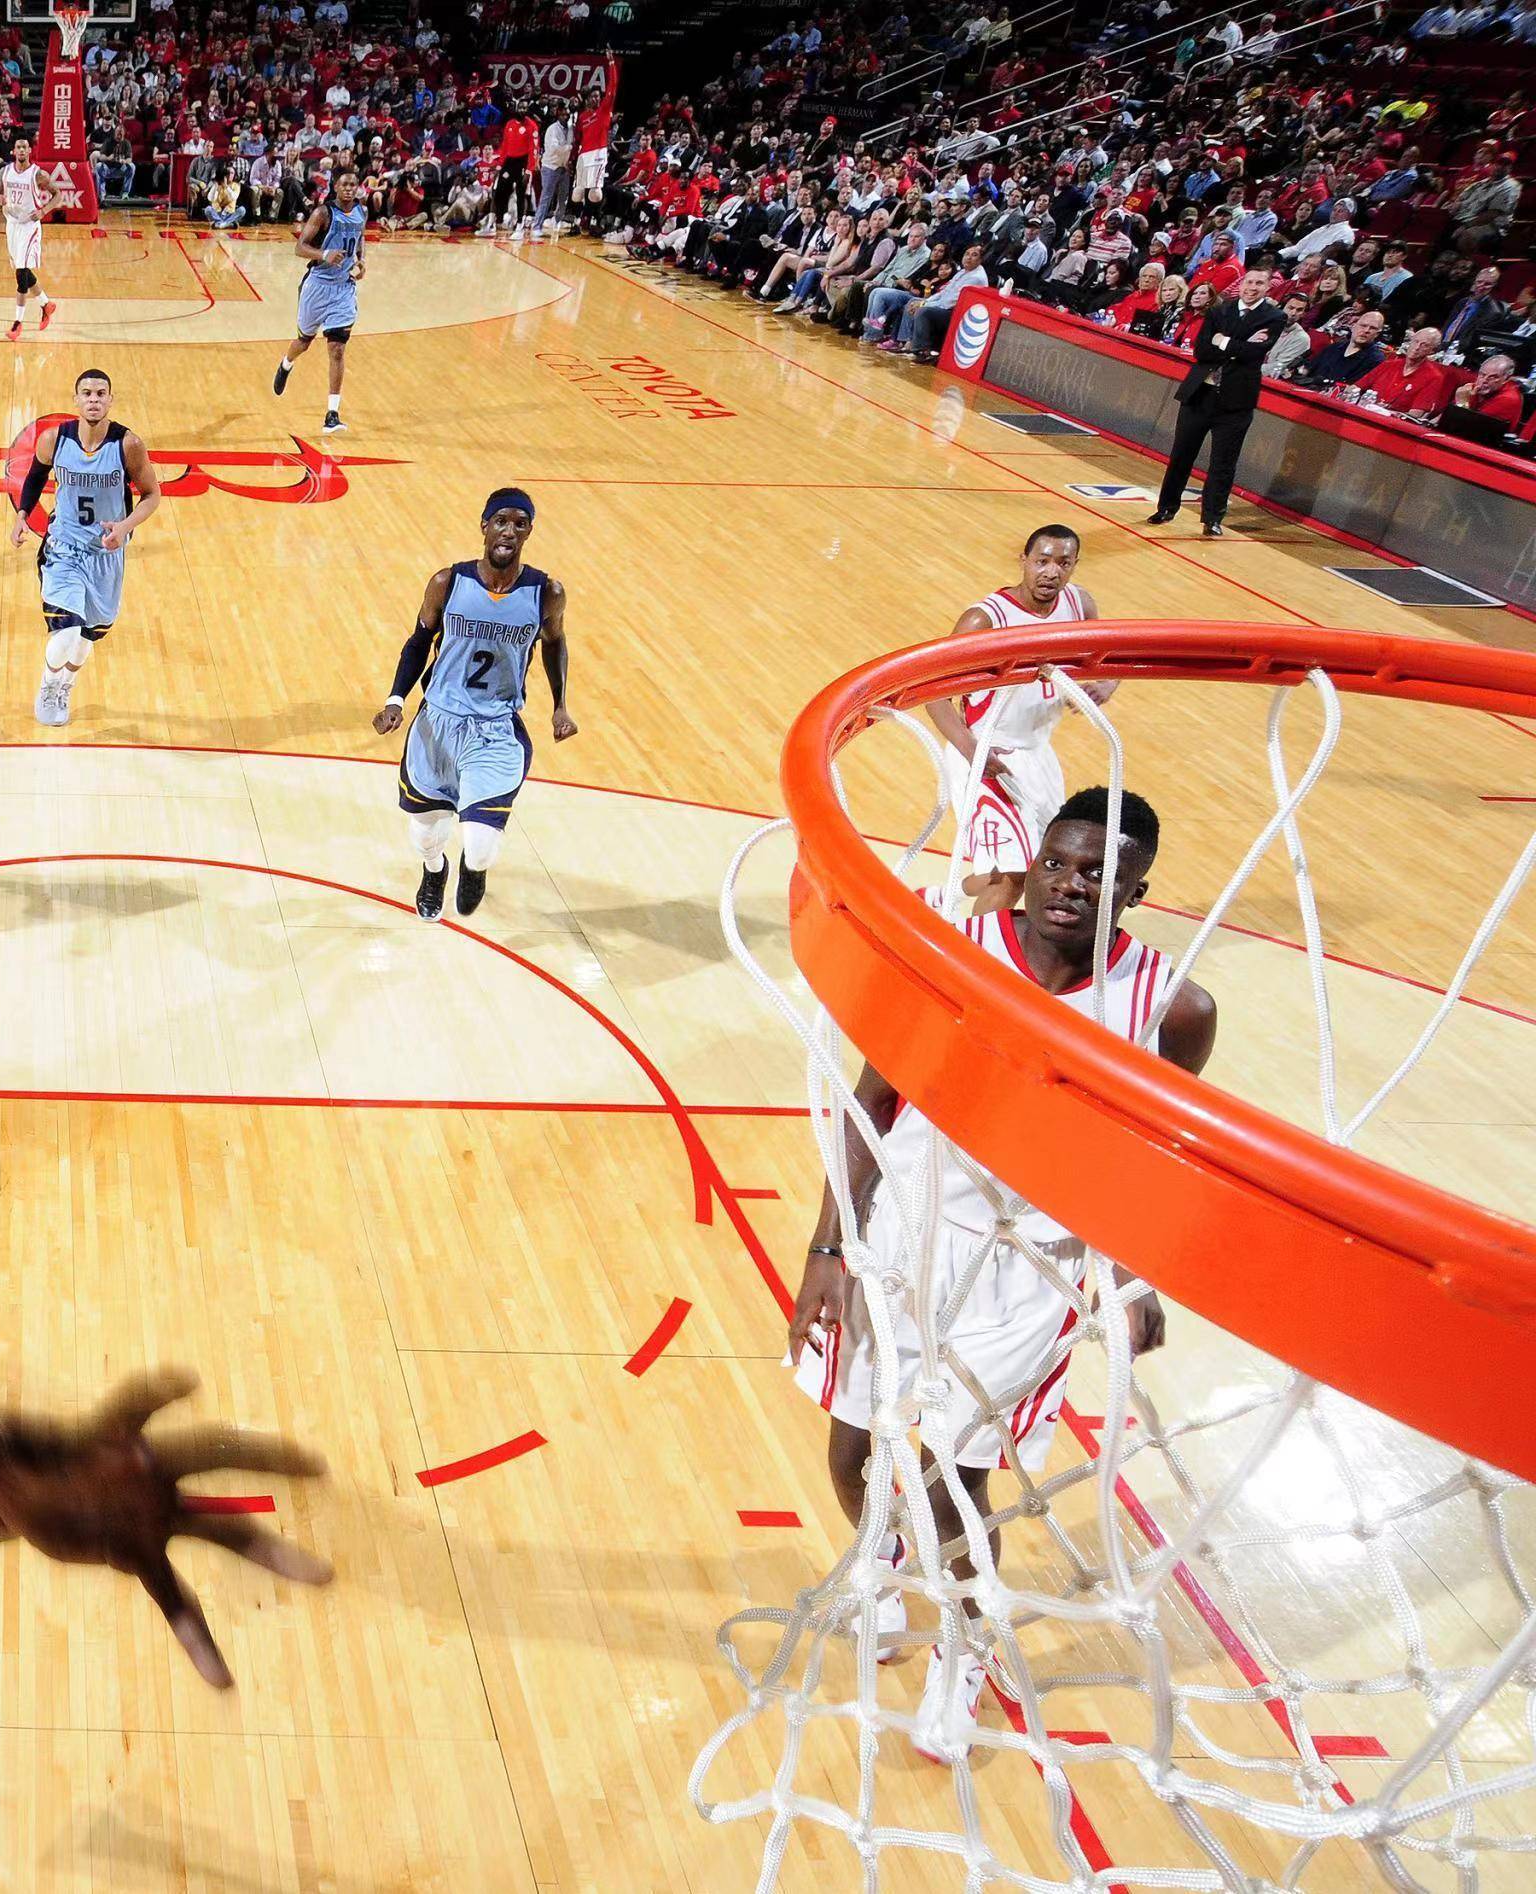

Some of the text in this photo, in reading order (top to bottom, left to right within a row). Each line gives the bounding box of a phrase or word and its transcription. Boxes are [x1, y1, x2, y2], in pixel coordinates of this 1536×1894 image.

[488, 63, 607, 92] TOYOTA
[54, 83, 72, 150] 中国匹克
[11, 190, 23, 205] 32
[535, 353, 661, 418] CENTER
[598, 354, 738, 419] TOYOTA
[56, 465, 122, 489] MEMPHIS
[77, 495, 96, 526] 5
[448, 613, 535, 645] MEMPHIS
[466, 650, 495, 690] 2
